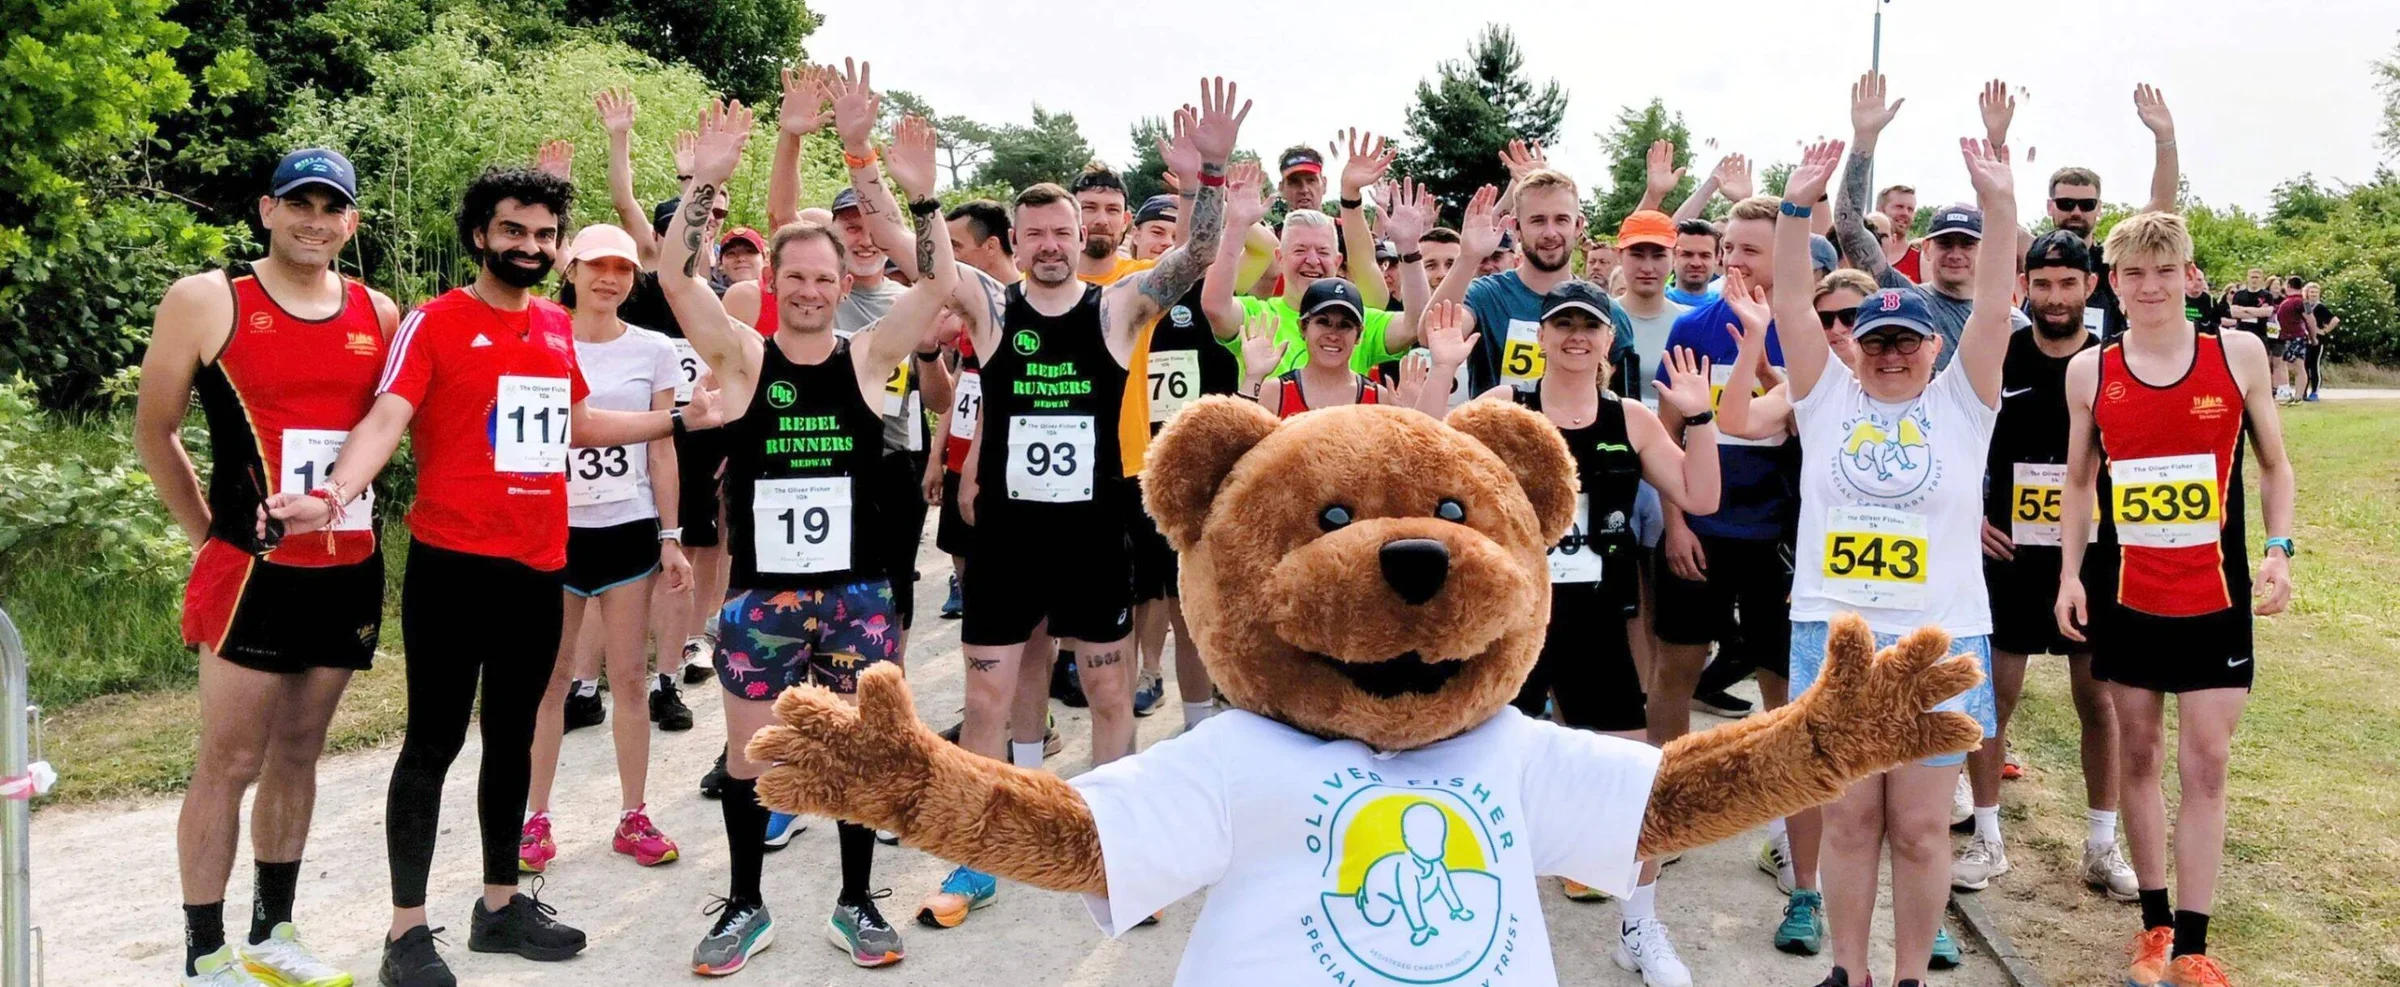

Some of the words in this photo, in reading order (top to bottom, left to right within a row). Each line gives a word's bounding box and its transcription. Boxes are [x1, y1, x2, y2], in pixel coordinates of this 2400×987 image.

[1026, 362, 1077, 378] REBEL
[1013, 380, 1092, 396] RUNNERS
[1147, 371, 1188, 401] 76
[1033, 400, 1070, 408] MEDWAY
[508, 406, 569, 445] 117
[779, 416, 840, 431] REBEL
[766, 436, 854, 454] RUNNERS
[1026, 442, 1077, 477] 93
[790, 458, 833, 468] MEDWAY
[2121, 483, 2211, 522] 539
[778, 506, 830, 544] 19
[1829, 536, 1920, 579] 543
[1494, 913, 1518, 976] TRUST
